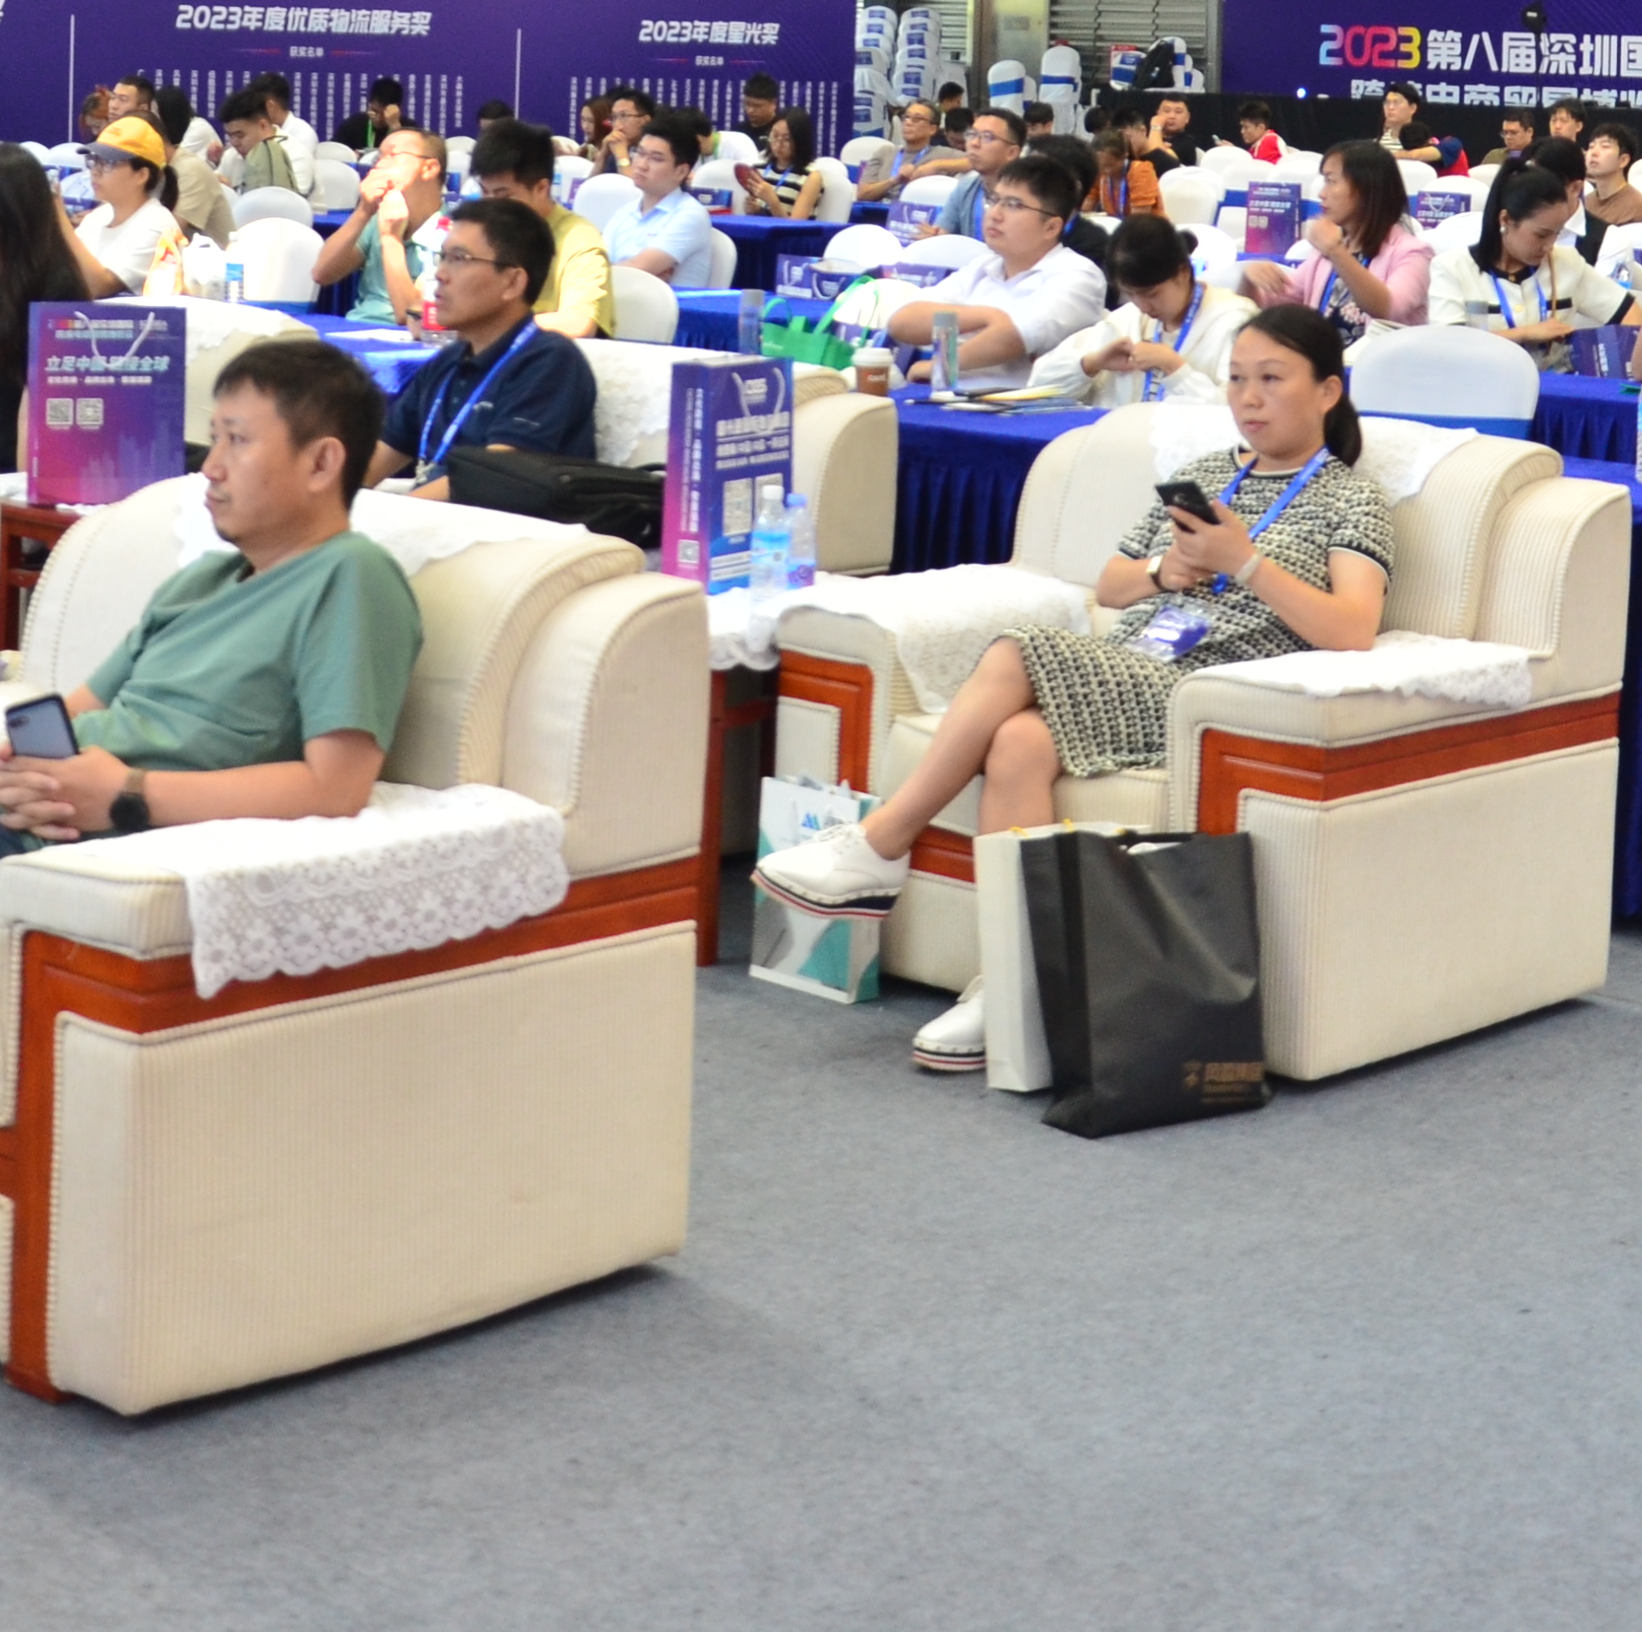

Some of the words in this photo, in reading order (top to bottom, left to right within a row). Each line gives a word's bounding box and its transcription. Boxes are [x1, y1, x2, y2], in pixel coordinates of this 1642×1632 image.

[175, 4, 433, 36] 2023年度优质物流服务奖
[638, 19, 781, 46] 2023年度星光奖
[289, 45, 325, 58] 获奖名单
[695, 55, 725, 67] 获奖名单
